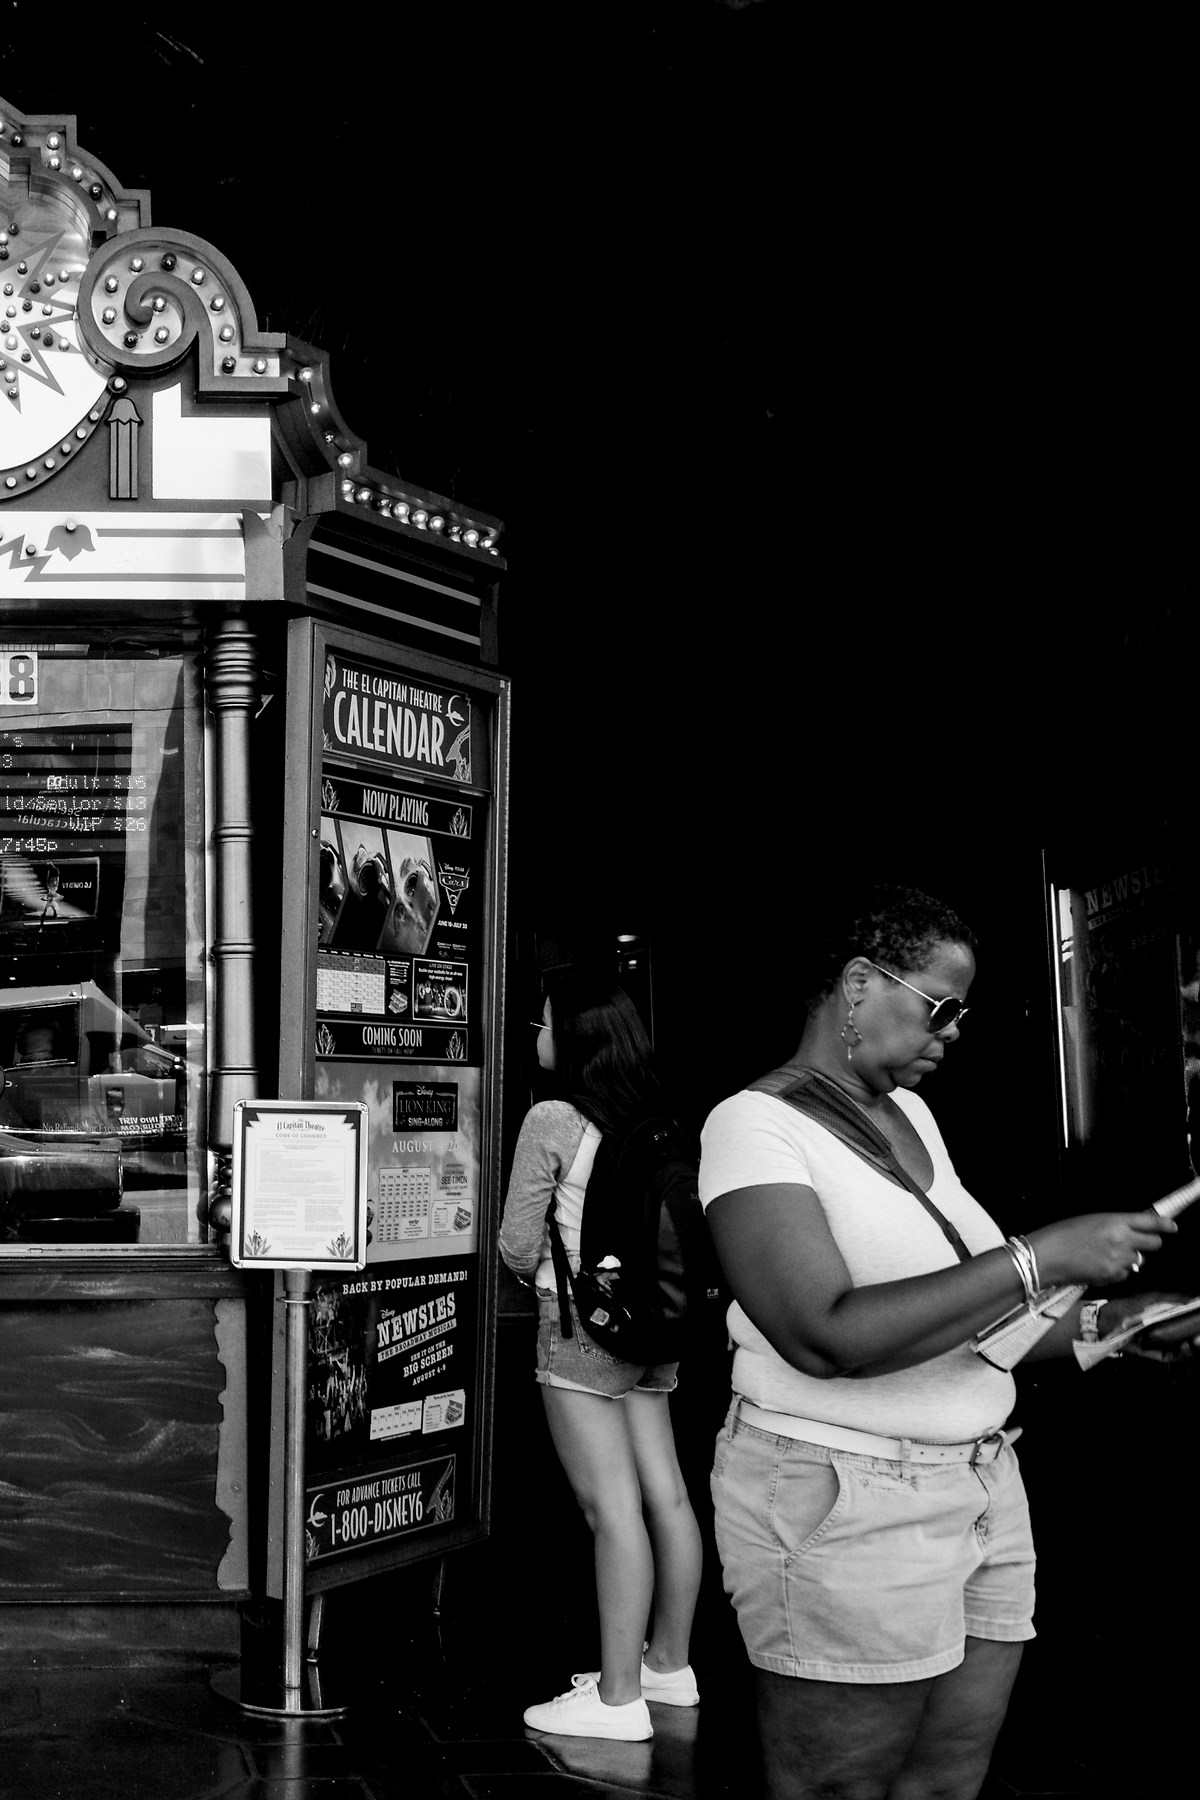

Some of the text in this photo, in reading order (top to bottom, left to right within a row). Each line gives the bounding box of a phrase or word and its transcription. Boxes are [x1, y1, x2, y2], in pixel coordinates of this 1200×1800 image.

[342, 668, 443, 713] THE EL CAPITAN THEATRE
[333, 691, 445, 767] CALENDAR
[2, 754, 13, 768] 3
[47, 775, 146, 790] dult $16
[113, 796, 147, 810] $13
[362, 788, 429, 826] NOW PLAYING
[113, 817, 147, 831] $26
[2, 838, 59, 853] 7:45p
[1084, 864, 1165, 915] NEWSIE
[449, 894, 458, 907] 3
[362, 1026, 422, 1047] COMING SOON
[400, 1100, 452, 1113] LION KING
[407, 1117, 443, 1127] SING-ALONG
[392, 1140, 433, 1152] AUGUST
[342, 1270, 468, 1295] BACK BY POPULAR DEMAND!
[376, 1292, 456, 1348] NEWSIES
[380, 1320, 455, 1360] THE BROADWAY MUSICAL
[403, 1344, 454, 1378] BIG SCREEN
[410, 1340, 446, 1362] SEE IT ON THE
[412, 1370, 436, 1386] AUGUST
[336, 1471, 421, 1507] FOR ADVANCE TICKETS CALL
[331, 1491, 423, 1545] 1-800-DISNEY6
